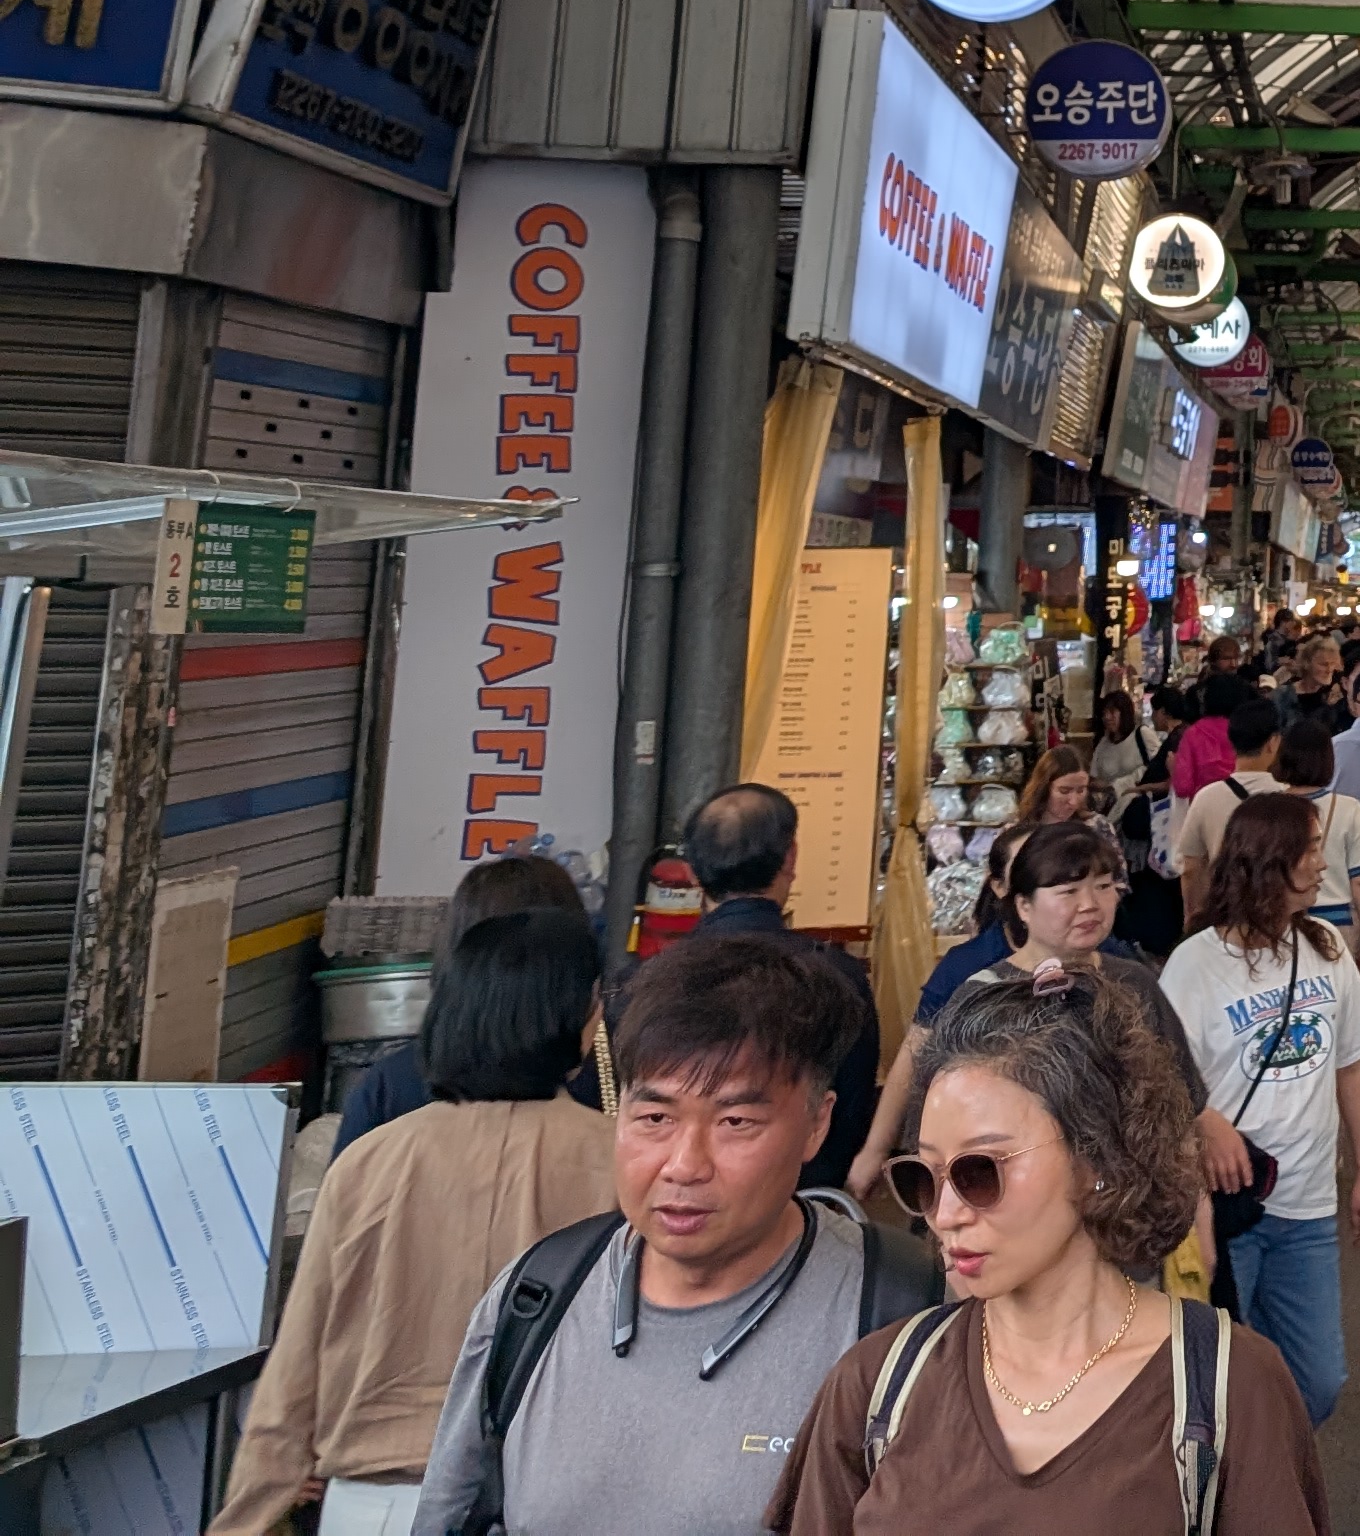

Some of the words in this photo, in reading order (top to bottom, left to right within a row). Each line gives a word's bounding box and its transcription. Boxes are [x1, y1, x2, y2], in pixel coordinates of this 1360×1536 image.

[1032, 80, 1158, 125] 오승주단
[1058, 142, 1138, 161] 2267-9017
[879, 151, 939, 271] COFFEE
[944, 211, 996, 315] WAFFLE
[496, 202, 589, 476] COFFEE
[169, 553, 181, 578] 2
[164, 585, 180, 608] 호
[460, 539, 565, 862] WAFFLE
[18, 1114, 37, 1142] STEEL
[111, 1114, 131, 1143] STEEL
[203, 1114, 222, 1142] STEEL
[76, 1268, 105, 1321] STAINLESS
[170, 1268, 199, 1321] STAINLESS
